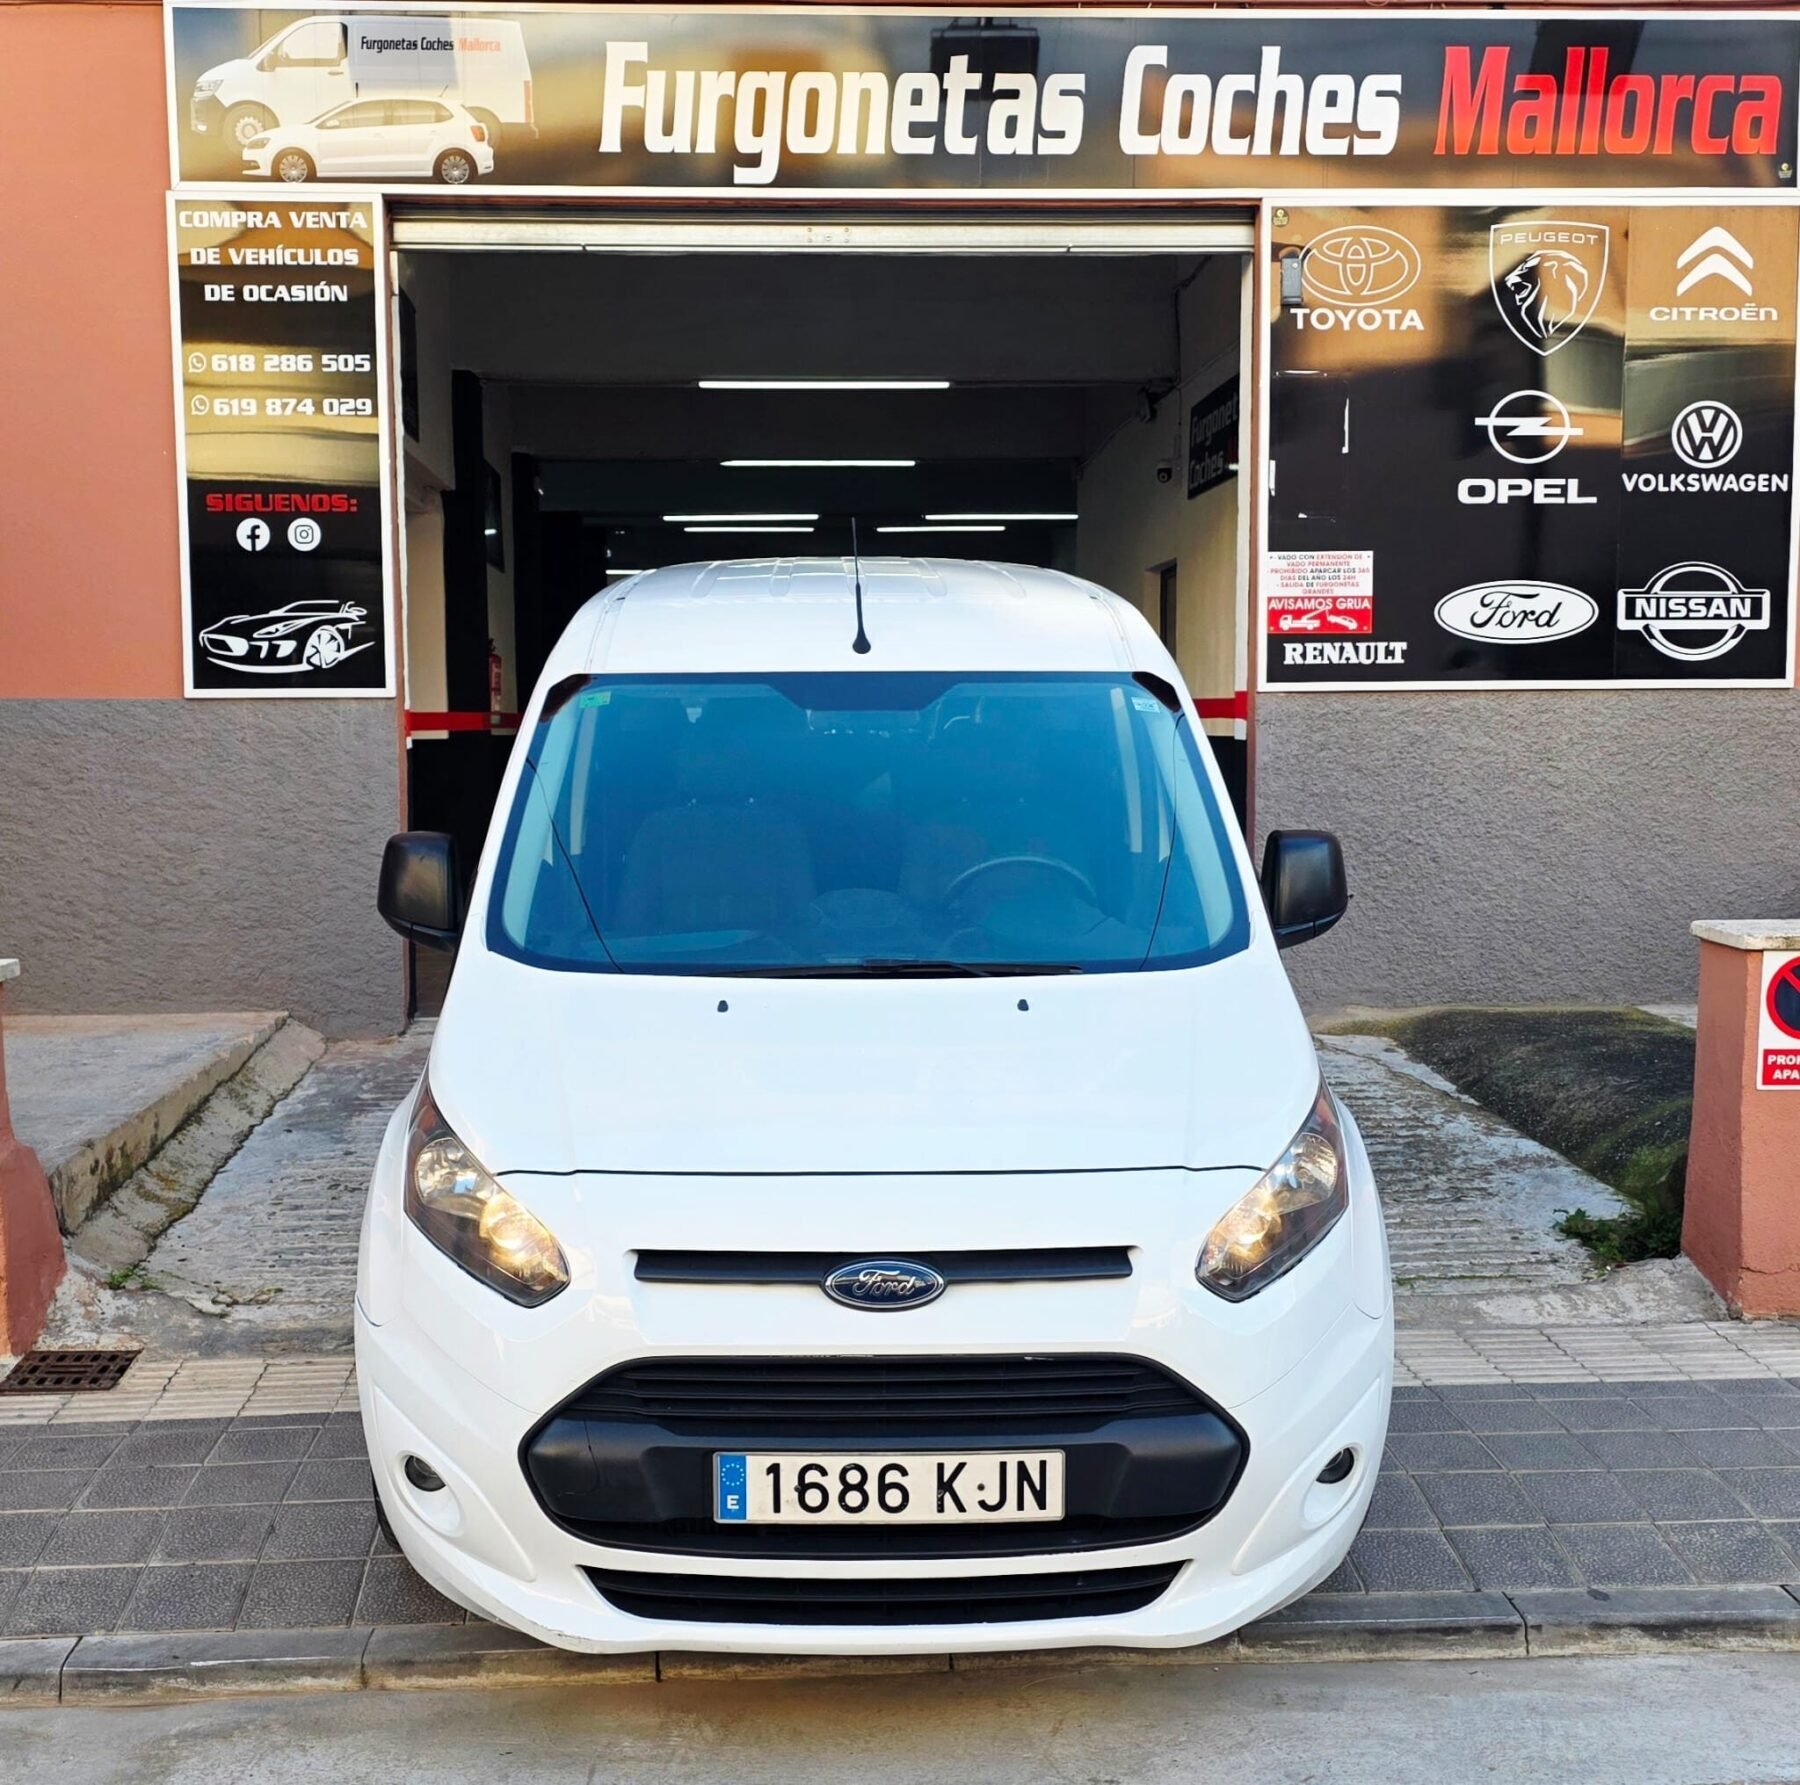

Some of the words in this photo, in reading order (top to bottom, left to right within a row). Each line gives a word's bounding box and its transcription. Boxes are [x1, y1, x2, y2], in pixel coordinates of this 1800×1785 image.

[360, 35, 419, 53] Furgonetas
[420, 36, 455, 51] Coches
[458, 37, 502, 52] Mallorca
[599, 41, 1086, 185] Furgonetas
[1119, 44, 1403, 157] Coches
[1433, 45, 1784, 157] Mallorca
[178, 210, 283, 229] COMPRA
[288, 210, 369, 229] VENTA
[1499, 230, 1599, 246] PEUGEOT
[189, 247, 222, 266] DE
[227, 243, 360, 266] VEHÍCULOS
[203, 284, 236, 302] DE
[242, 280, 348, 302] OCASIÓN
[1289, 307, 1425, 331] TOYOTA
[210, 353, 256, 373] 618
[263, 353, 314, 373] 286
[321, 353, 372, 373] 505
[212, 397, 258, 417] 619
[265, 398, 316, 417] 874
[322, 397, 373, 417] 029
[1189, 451, 1225, 490] Coches
[1457, 477, 1598, 505] OPEL
[1621, 473, 1790, 493] VOLKSWAGEN
[205, 493, 359, 513] SIGUENOS:
[1354, 552, 1363, 560] DE
[1268, 597, 1333, 610] AVISAMOS
[1335, 597, 1372, 610] GRUA
[1469, 590, 1564, 629] Ford
[1634, 597, 1752, 619] NISSAN
[1282, 641, 1408, 665] RENAULT
[852, 1268, 917, 1297] Ford
[765, 1462, 911, 1515] 1686
[935, 1459, 1048, 1513] KJN
[726, 1494, 740, 1510] E
